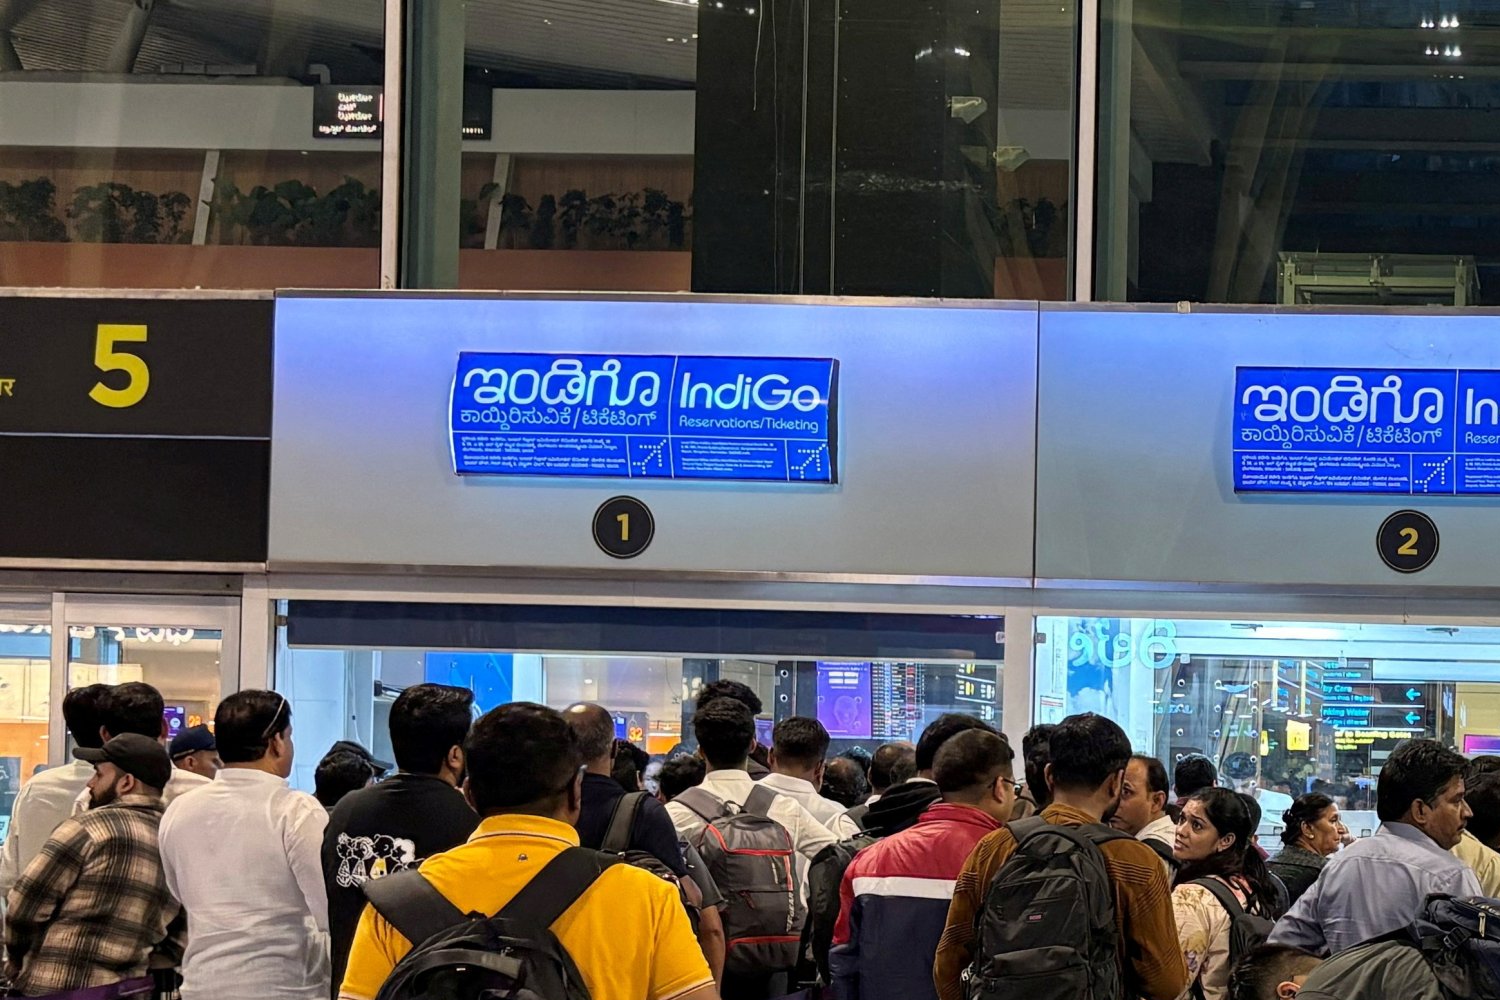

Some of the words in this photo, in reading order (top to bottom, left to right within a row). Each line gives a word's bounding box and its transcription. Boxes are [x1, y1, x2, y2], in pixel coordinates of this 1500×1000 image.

[88, 324, 150, 408] 5
[679, 371, 820, 411] IndiGo
[679, 415, 819, 434] Reservations/Ticketing
[616, 513, 629, 541] 1
[1397, 527, 1419, 556] 2
